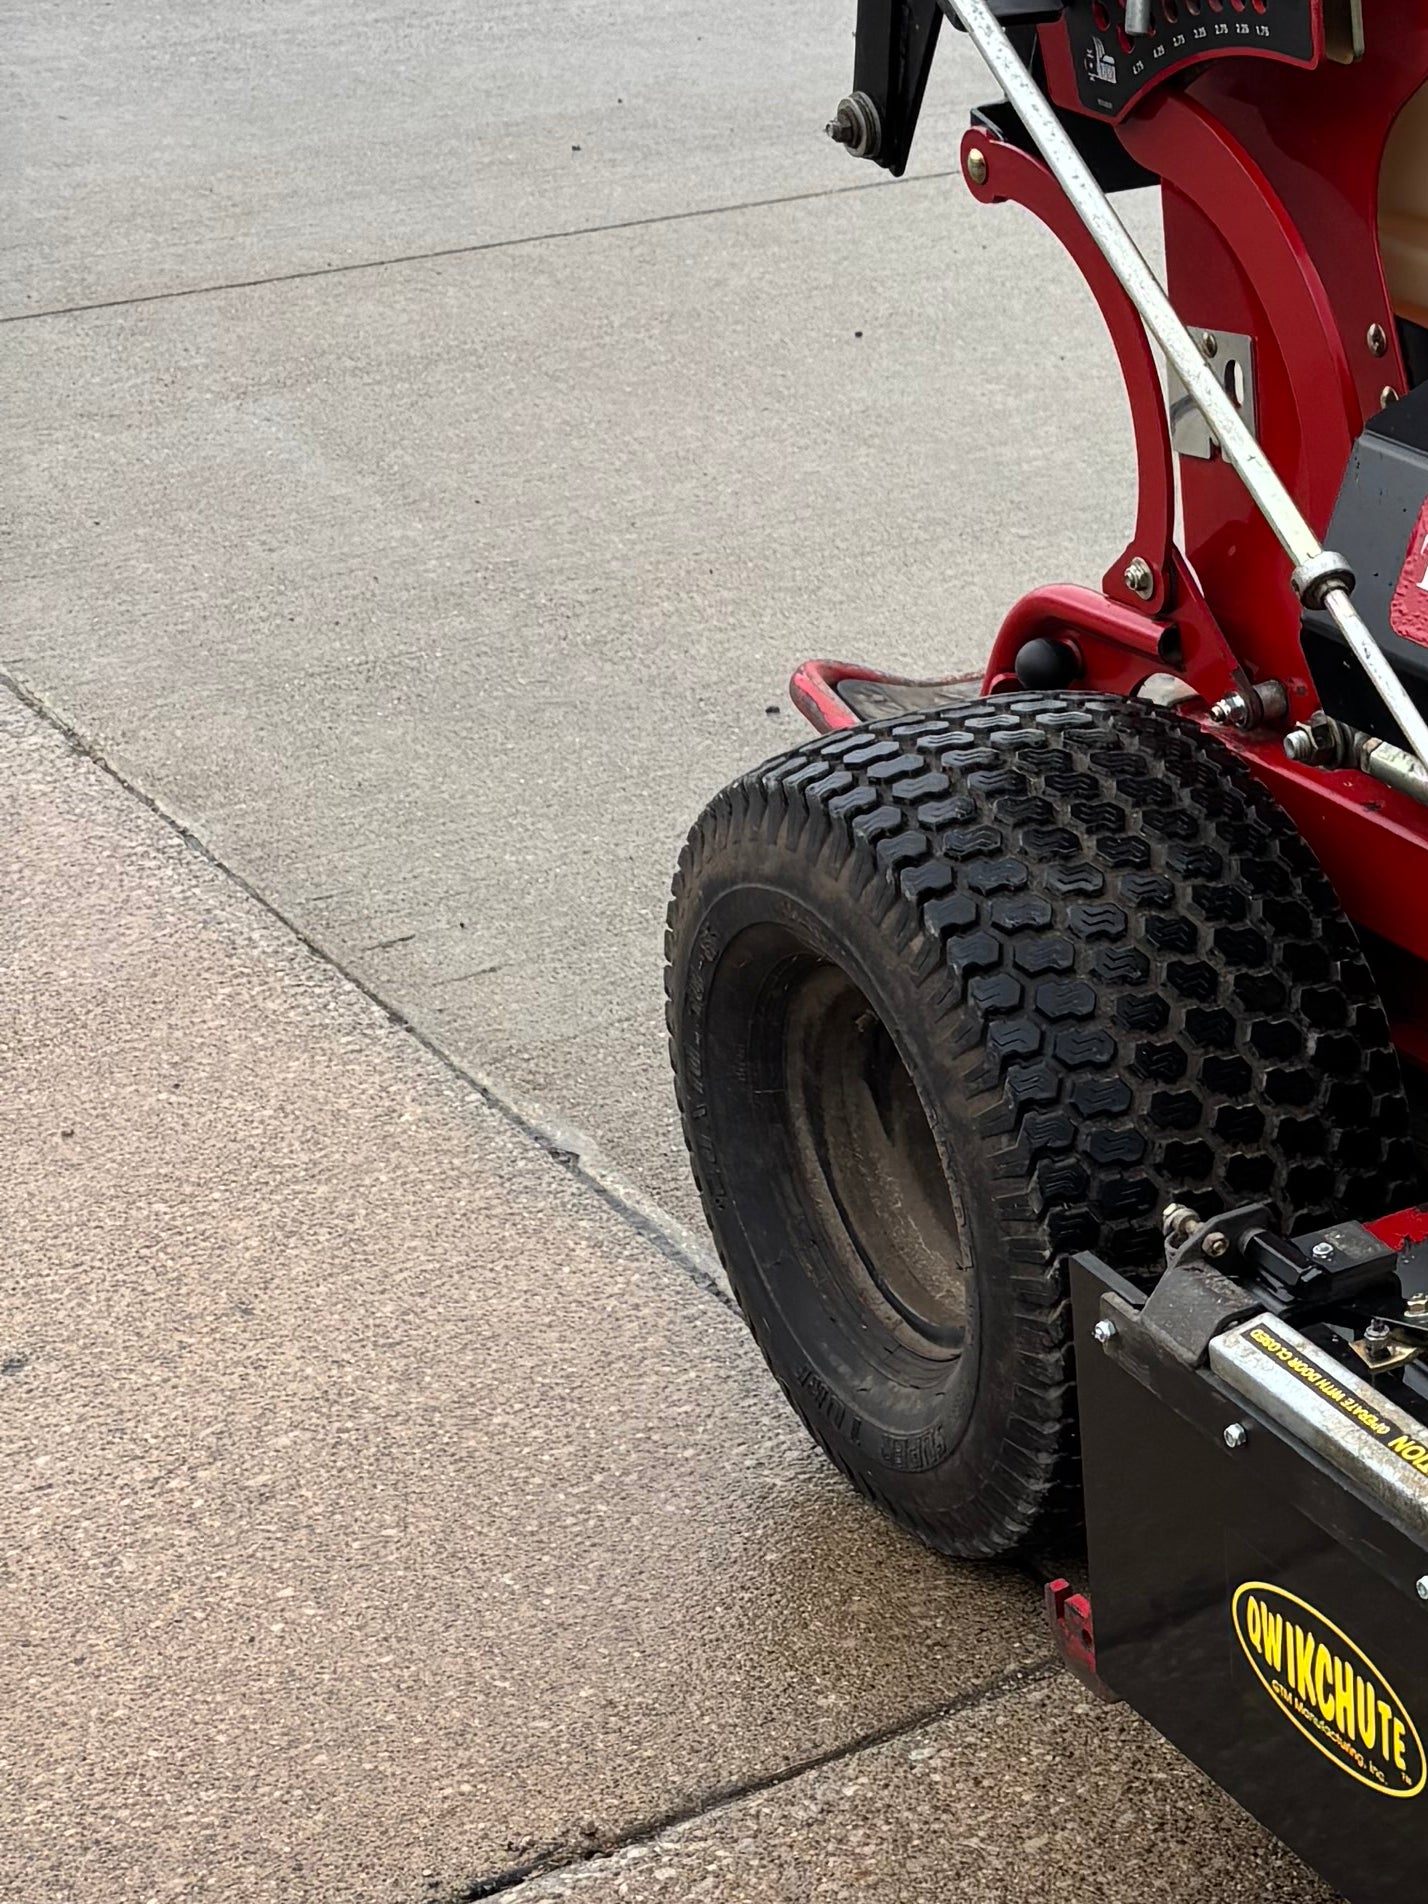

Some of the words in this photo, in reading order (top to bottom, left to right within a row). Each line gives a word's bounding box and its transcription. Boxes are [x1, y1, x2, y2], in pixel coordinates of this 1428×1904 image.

[1250, 1328, 1292, 1360] CLOSED
[1288, 1357, 1322, 1382] DOOR
[1315, 1378, 1346, 1402] WITH
[1340, 1398, 1390, 1434] OPERATE
[1247, 1595, 1406, 1771] QWIKCHUTE
